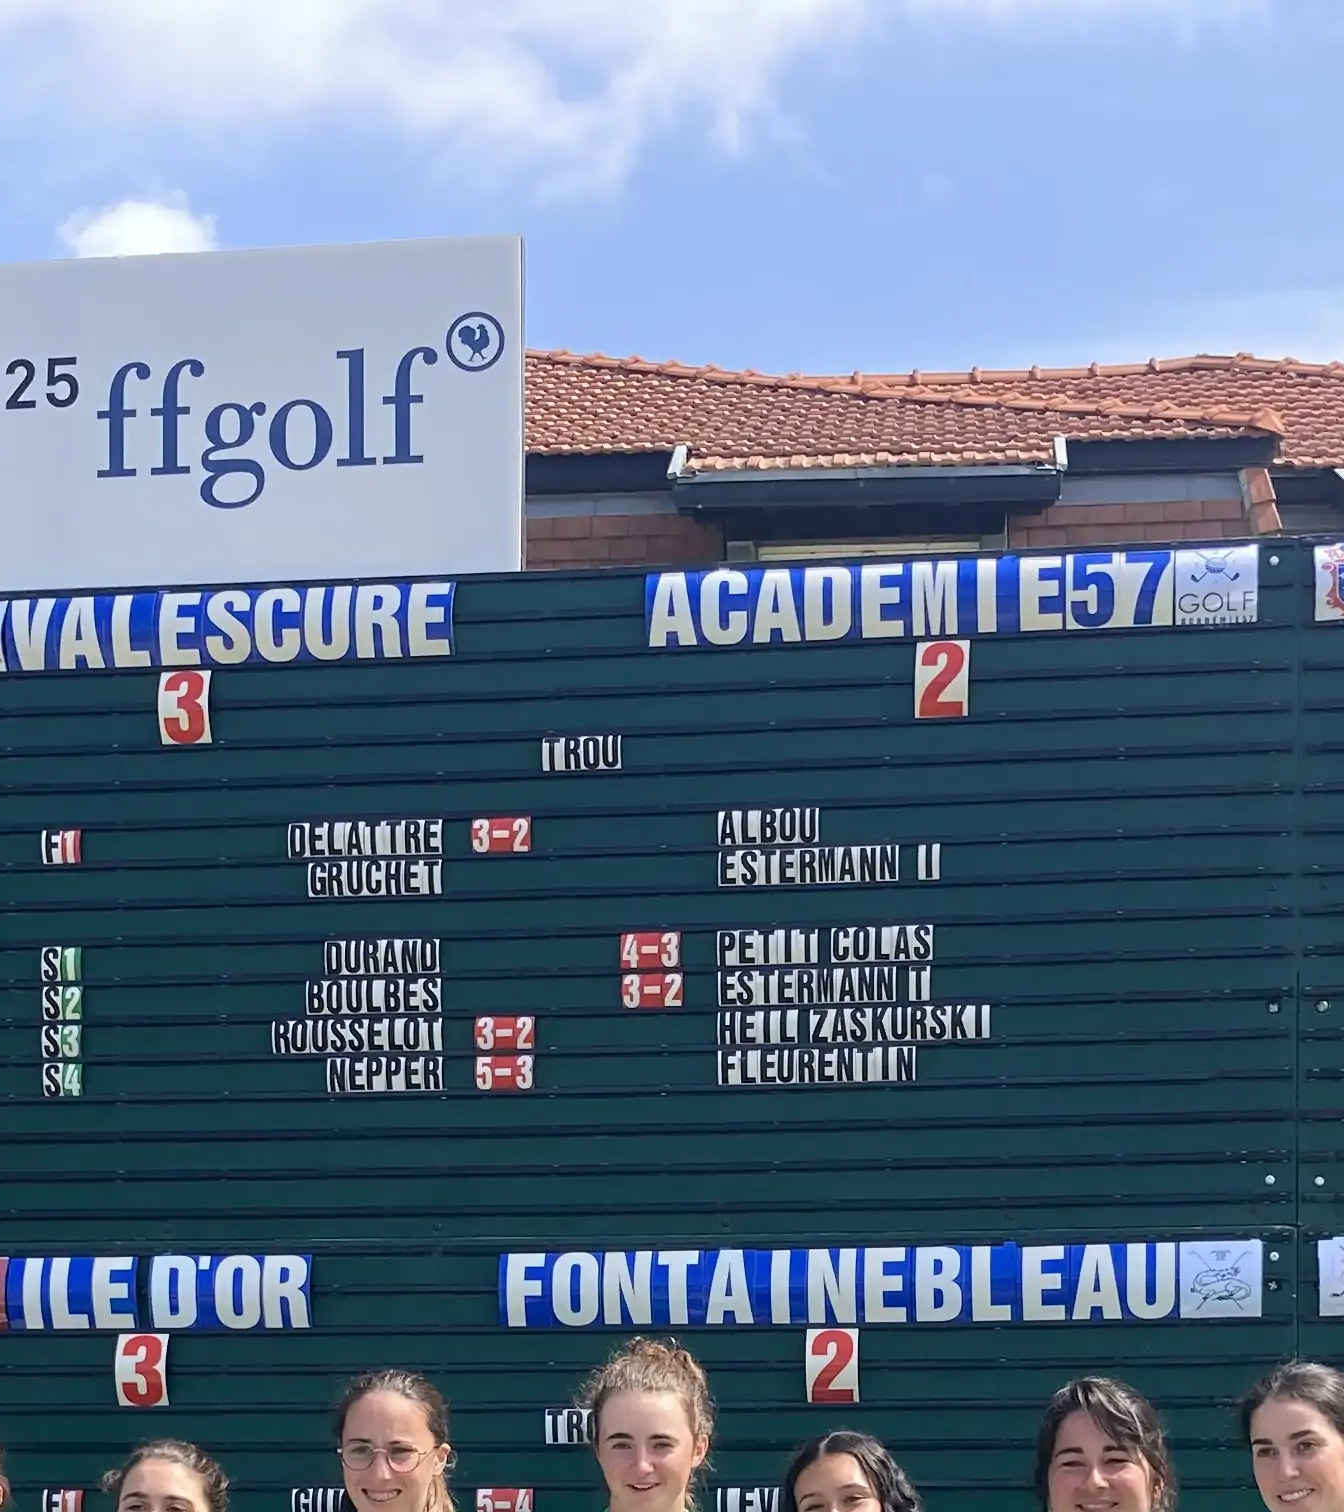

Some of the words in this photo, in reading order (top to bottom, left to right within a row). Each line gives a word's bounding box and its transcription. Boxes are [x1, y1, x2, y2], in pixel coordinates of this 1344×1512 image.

[96, 346, 438, 509] ffgolf
[11, 583, 453, 671] VALESCURE
[1178, 591, 1254, 614] GOLF
[162, 671, 205, 744] 3
[917, 641, 966, 717] 2
[543, 736, 621, 770] TROU
[42, 830, 80, 864] F1
[289, 819, 442, 858] DELATTRE
[472, 817, 531, 852] 3-2
[719, 808, 818, 845] ALBOU
[309, 860, 442, 897] GRUCHET
[719, 845, 898, 885] ESTERMANN
[42, 947, 80, 981] S1
[325, 939, 440, 975] DURAND
[621, 932, 680, 968] 4-3
[718, 930, 817, 966] PETIT
[831, 925, 933, 962] COLAS
[43, 986, 82, 1020] S2
[307, 979, 440, 1014] BOULBES
[622, 973, 683, 1009] 3-2
[719, 967, 896, 1006] ESTERMANN
[910, 966, 930, 1001] T
[43, 1025, 82, 1057] S3
[273, 1018, 442, 1054] ROUSSELOT
[475, 1016, 534, 1050] 3-2
[718, 1009, 798, 1045] HEIL
[810, 1005, 989, 1043] ZASKURSKI
[43, 1063, 82, 1096] S4
[327, 1057, 443, 1092] NEPPER
[475, 1055, 534, 1091] 5-3
[719, 1046, 916, 1085] FLEURENTIN
[23, 1256, 137, 1329] ILE
[151, 1255, 311, 1329] D'OR
[506, 1242, 1176, 1327] FONTAINEBLEAU
[122, 1334, 165, 1407] 3
[811, 1329, 855, 1403] 2
